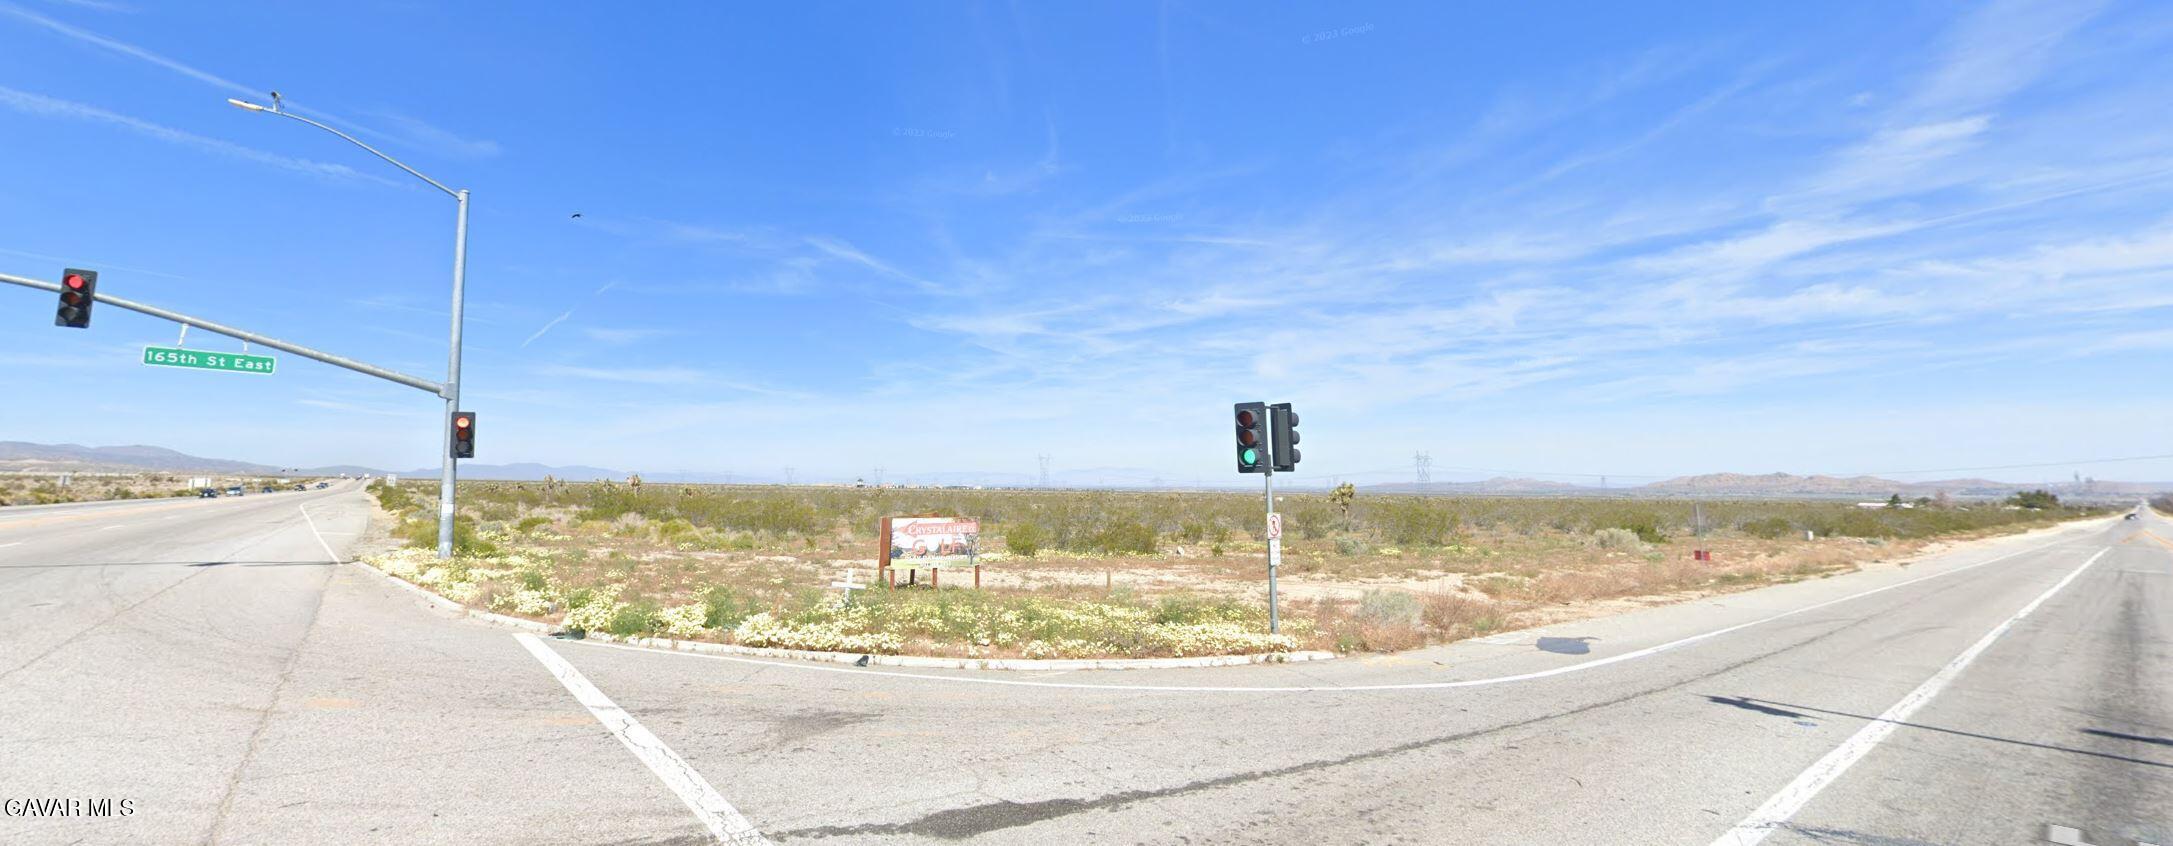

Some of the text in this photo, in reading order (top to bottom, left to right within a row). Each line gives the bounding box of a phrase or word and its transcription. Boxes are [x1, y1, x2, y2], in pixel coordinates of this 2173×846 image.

[147, 351, 272, 370] 165th St East
